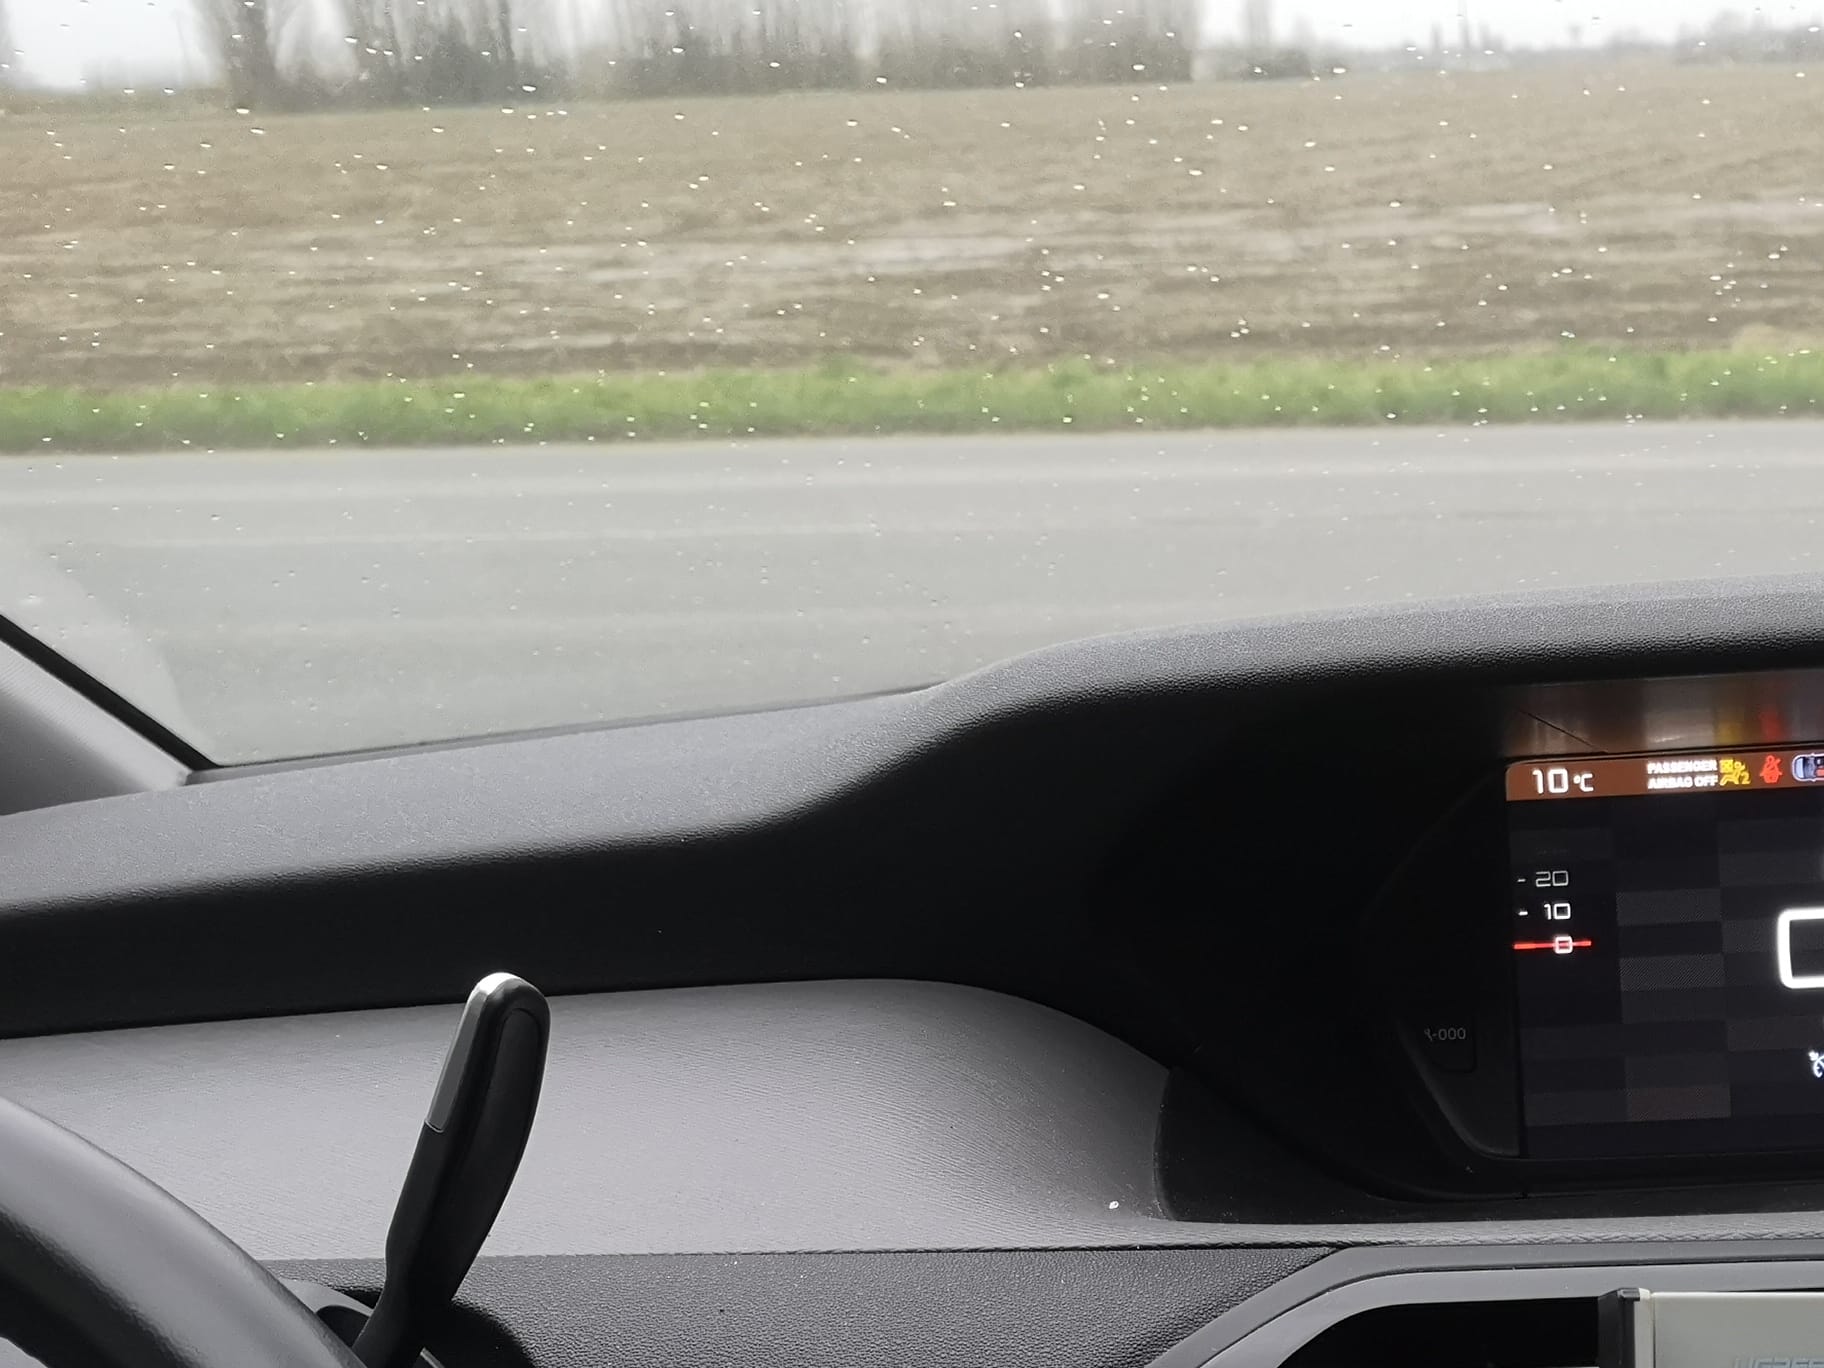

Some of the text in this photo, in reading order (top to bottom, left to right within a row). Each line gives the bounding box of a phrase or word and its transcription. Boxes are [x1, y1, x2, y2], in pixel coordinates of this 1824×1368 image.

[1646, 759, 1718, 774] PASSENGER
[1532, 767, 1569, 794] 10
[1648, 774, 1719, 789] AIRBAG OFF
[1535, 870, 1569, 887] 20
[1543, 903, 1571, 920] 10
